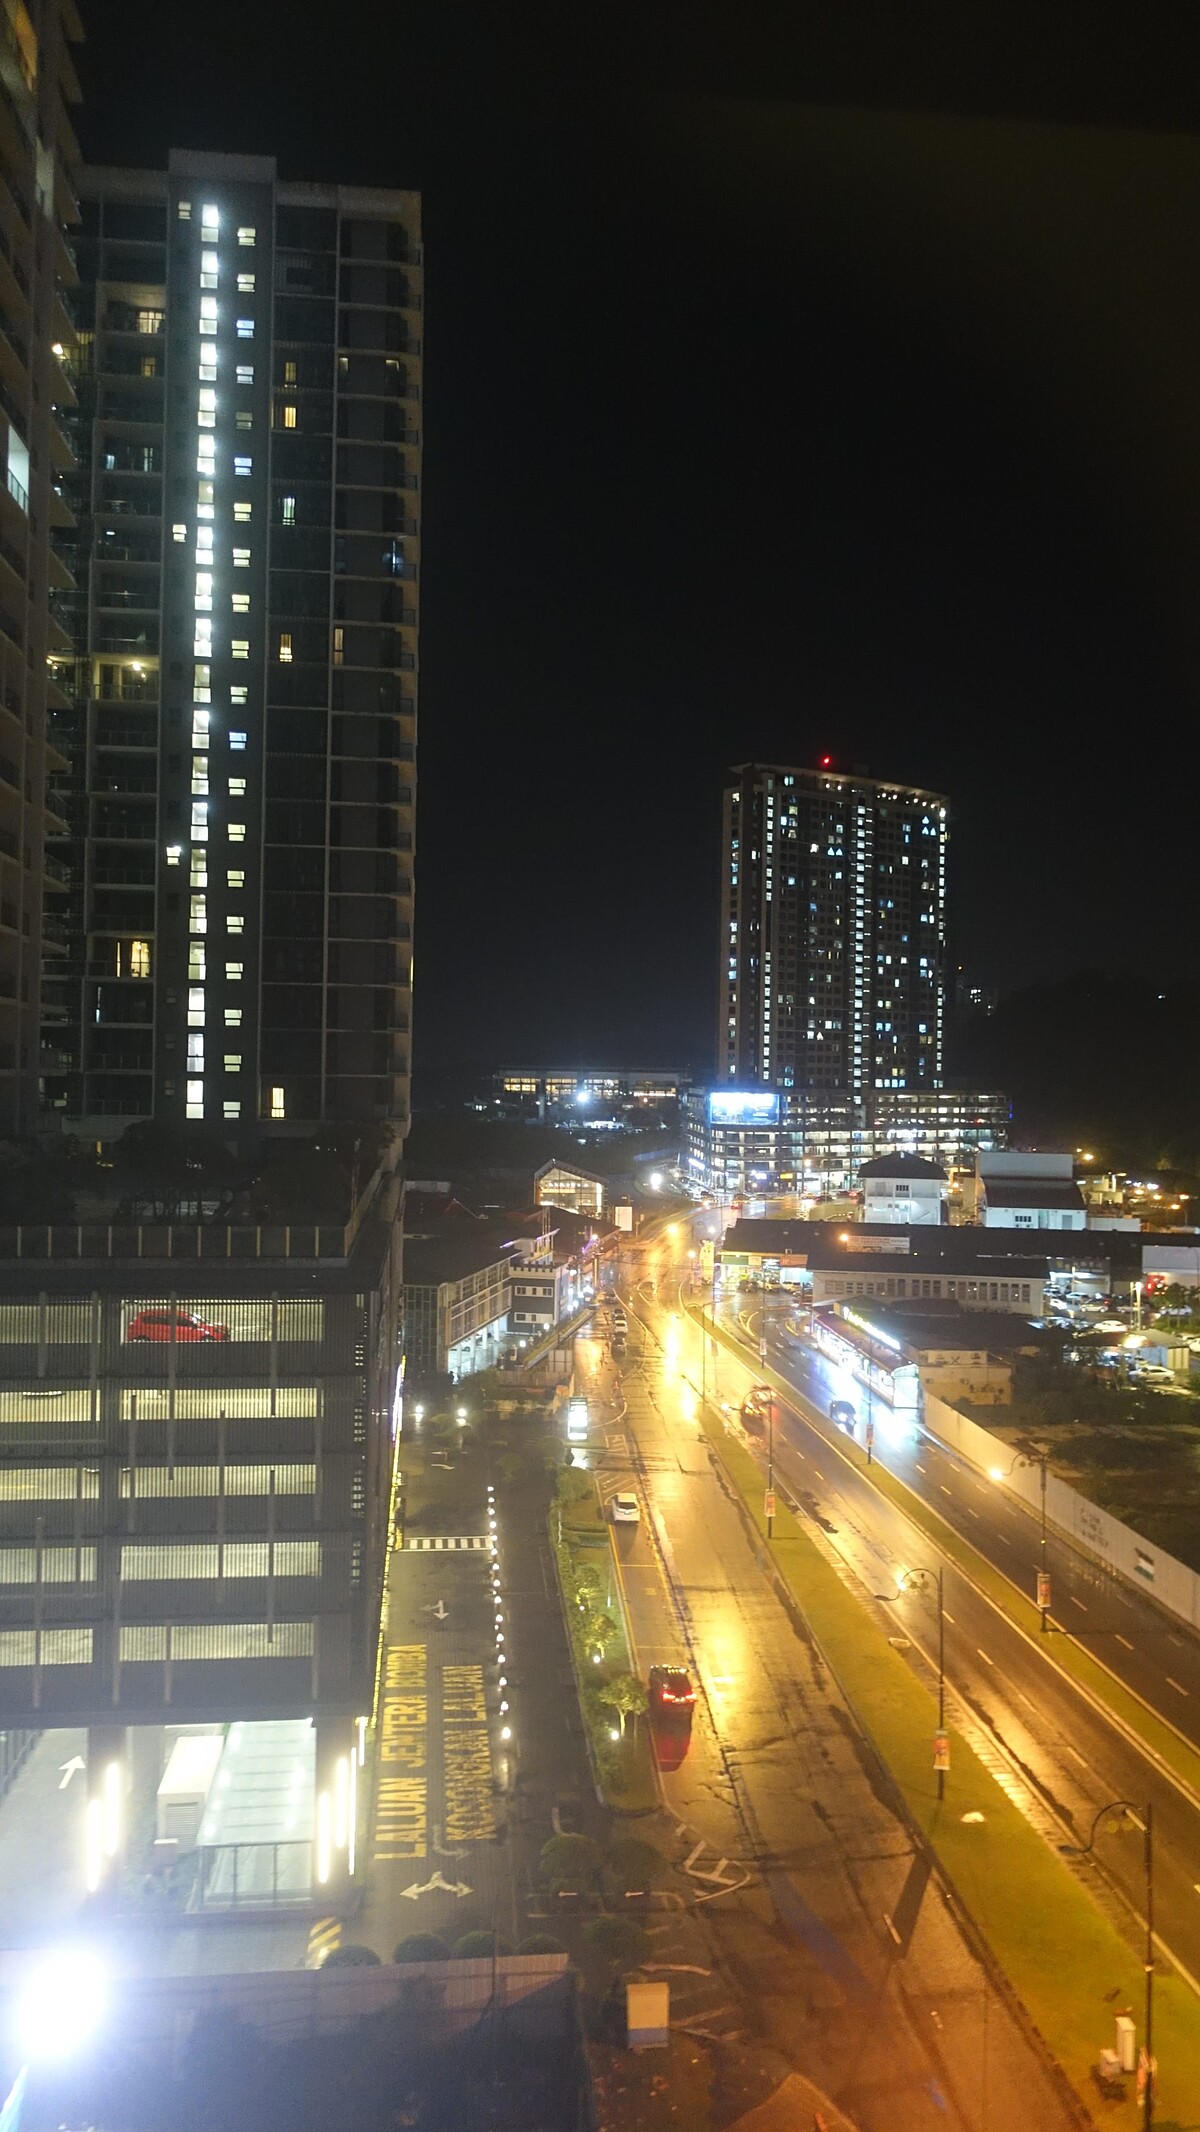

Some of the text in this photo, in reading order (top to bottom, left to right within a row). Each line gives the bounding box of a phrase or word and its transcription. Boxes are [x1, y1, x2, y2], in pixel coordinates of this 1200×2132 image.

[374, 1644, 428, 1860] LALUAN JENTERA BOMBA
[442, 1665, 497, 1841] KOSONGKAN LALUAN
